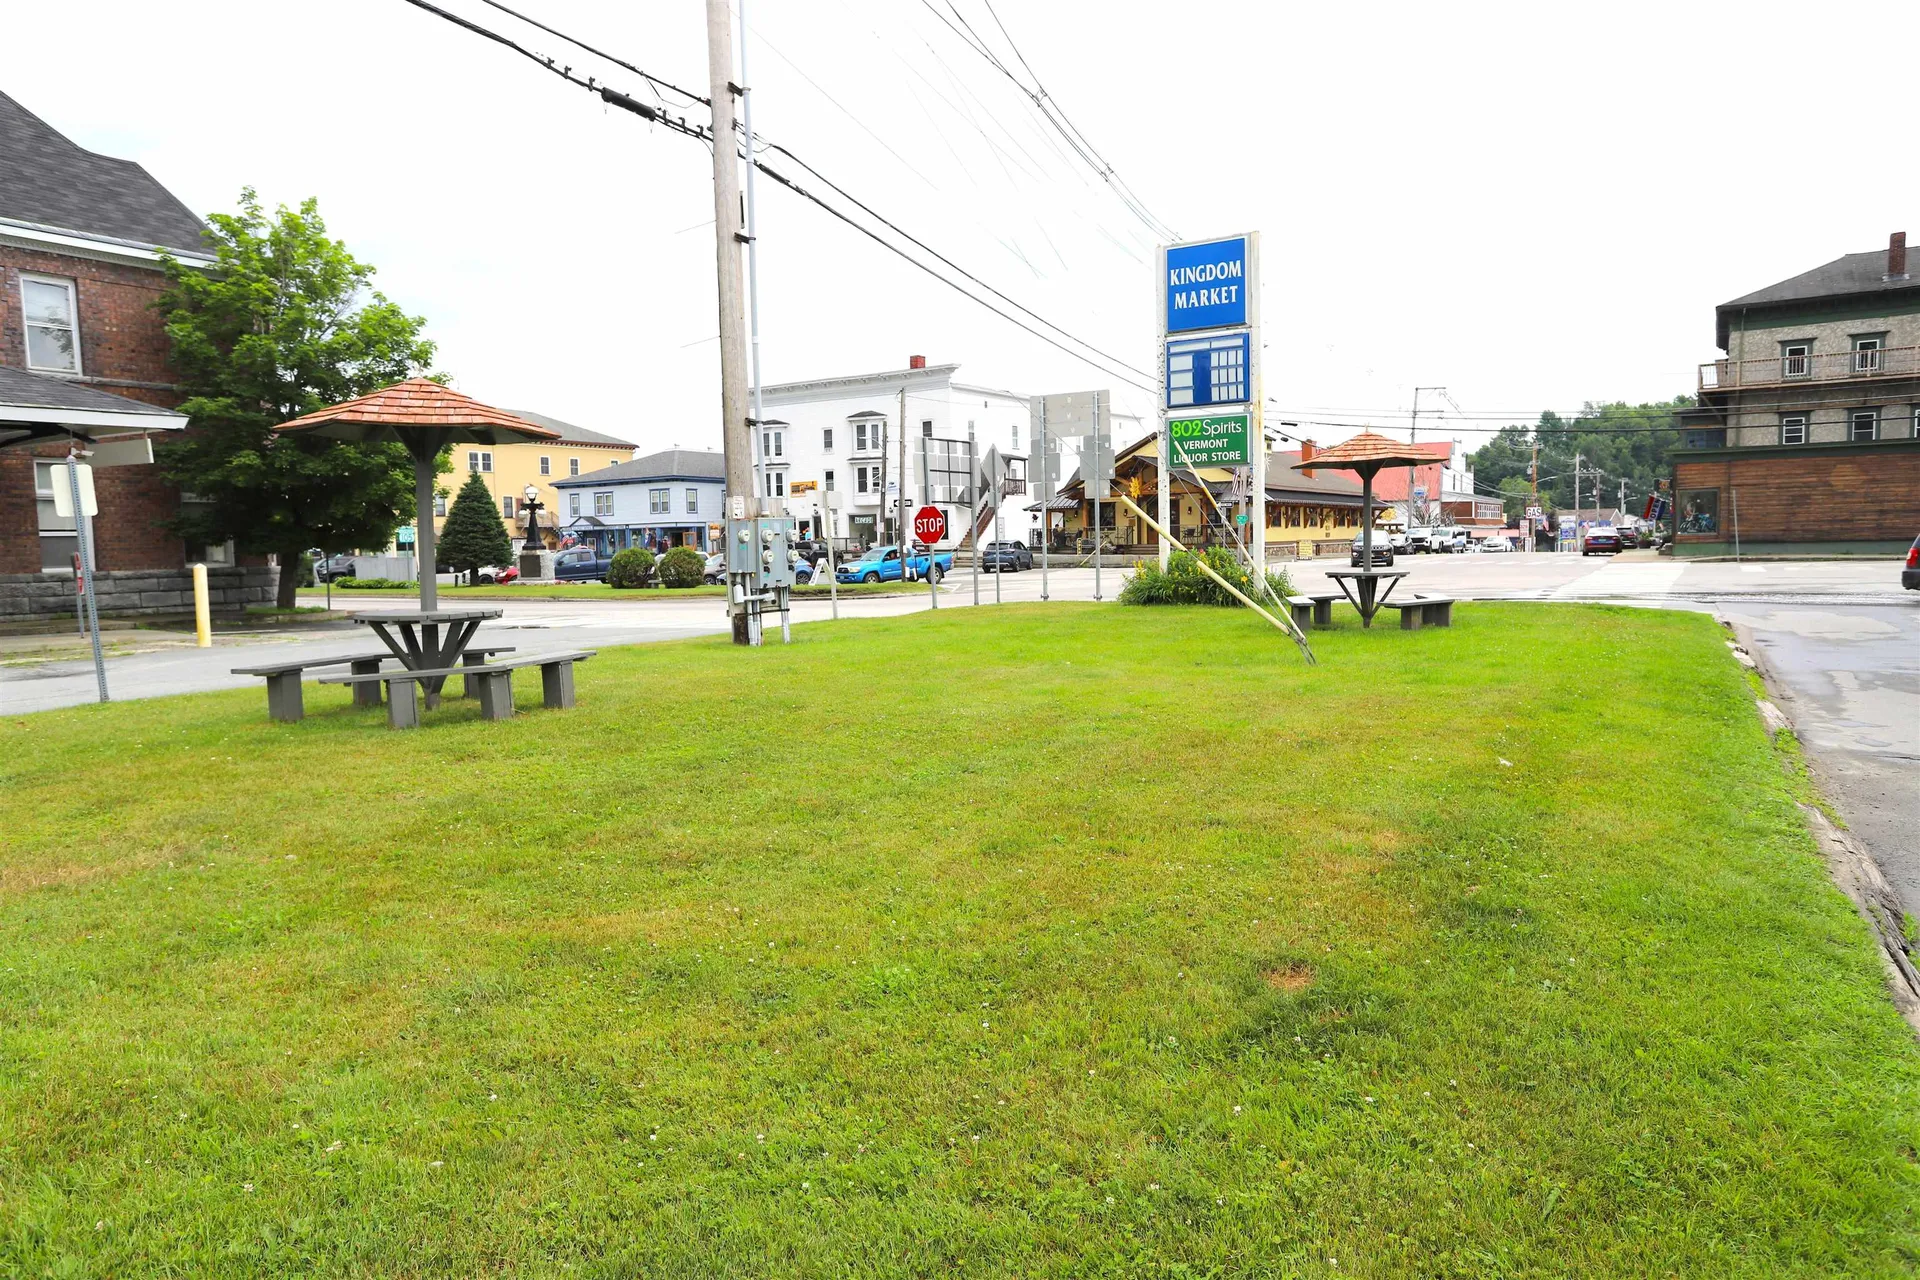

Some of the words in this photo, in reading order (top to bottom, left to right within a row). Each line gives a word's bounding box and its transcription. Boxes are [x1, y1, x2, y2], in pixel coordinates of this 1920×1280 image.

[1170, 260, 1242, 286] KINGDOM
[1174, 285, 1238, 310] MARKET
[1172, 420, 1202, 437] 802
[1202, 419, 1242, 437] Spirits
[1183, 438, 1228, 450] VERMONT
[1211, 451, 1241, 461] STORE
[1526, 507, 1541, 518] GAS
[916, 517, 943, 533] STOP
